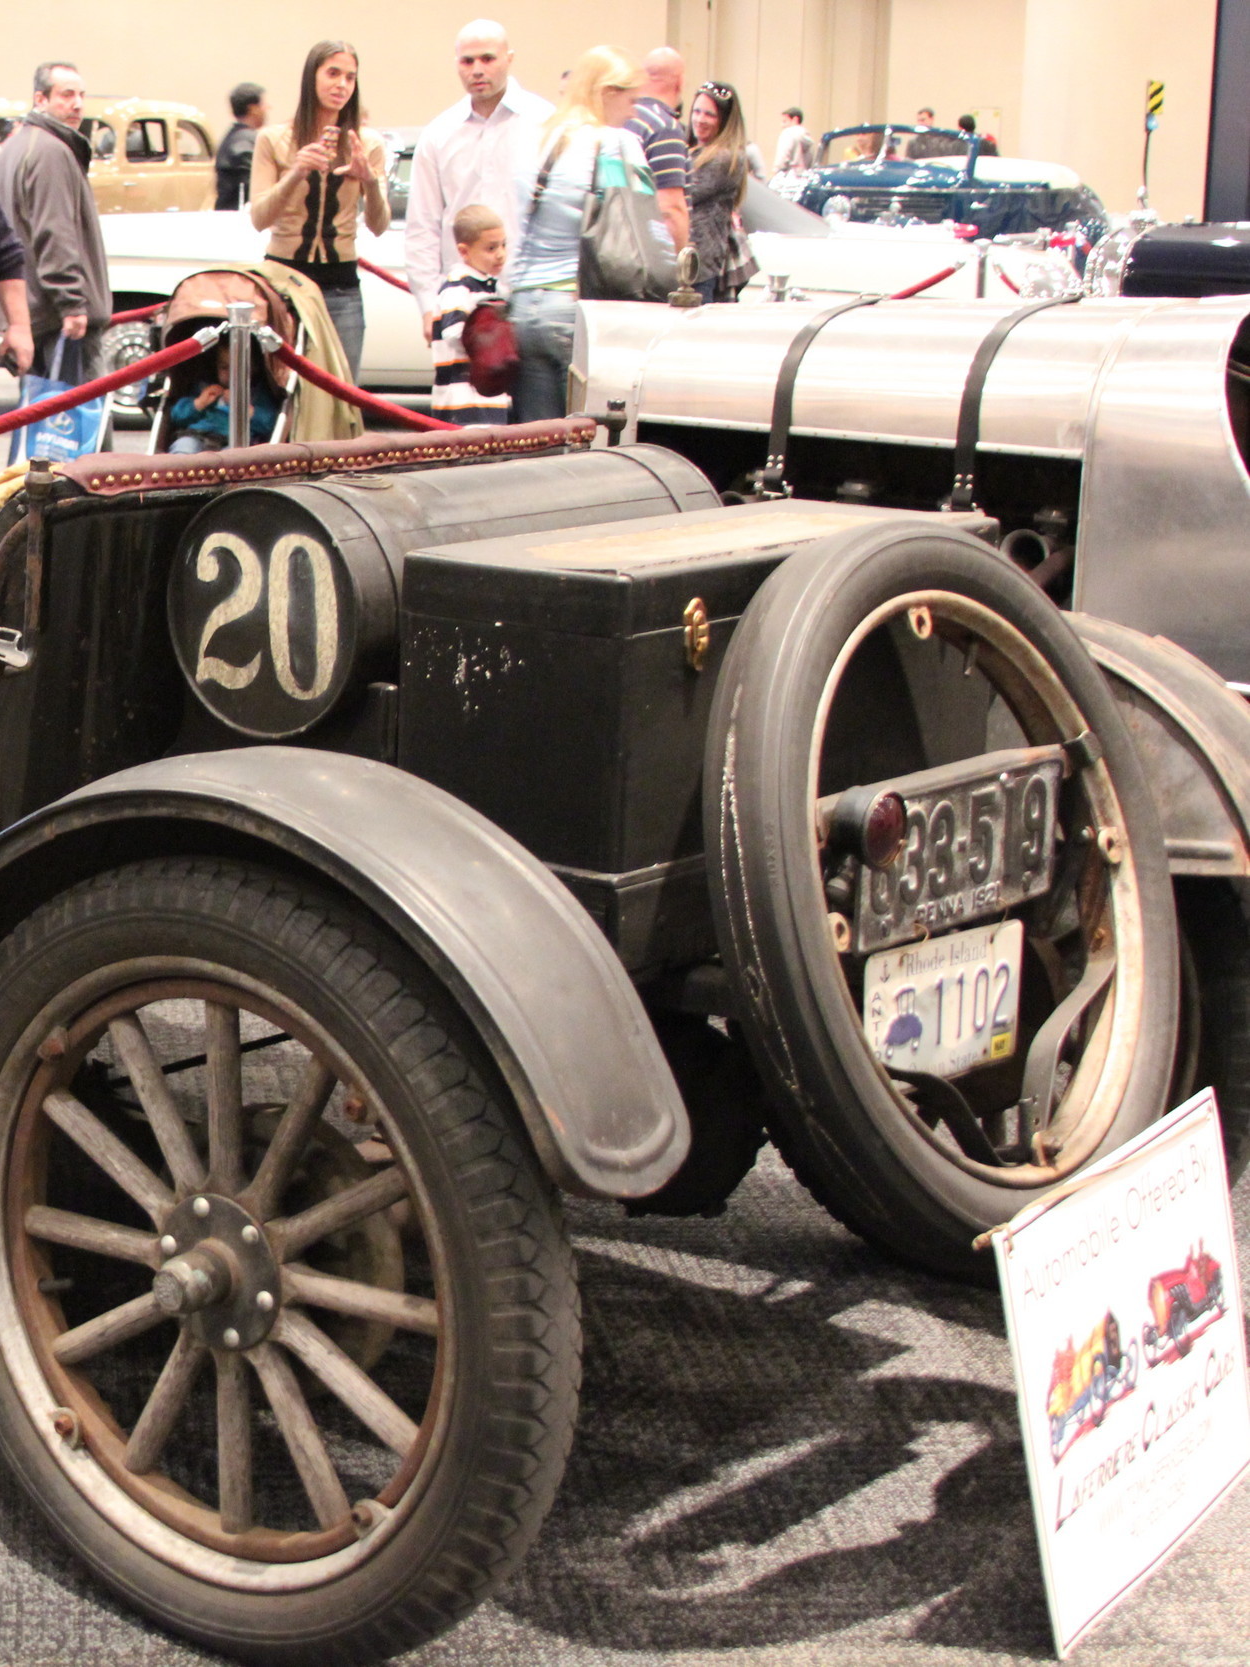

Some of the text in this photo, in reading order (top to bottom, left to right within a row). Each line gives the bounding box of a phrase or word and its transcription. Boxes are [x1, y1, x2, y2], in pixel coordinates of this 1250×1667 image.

[196, 531, 339, 700] 20
[905, 936, 988, 977] Rhode Island
[934, 962, 1011, 1046] 1102
[1022, 1201, 1120, 1313] Automobile
[1125, 1151, 1188, 1230] Offered
